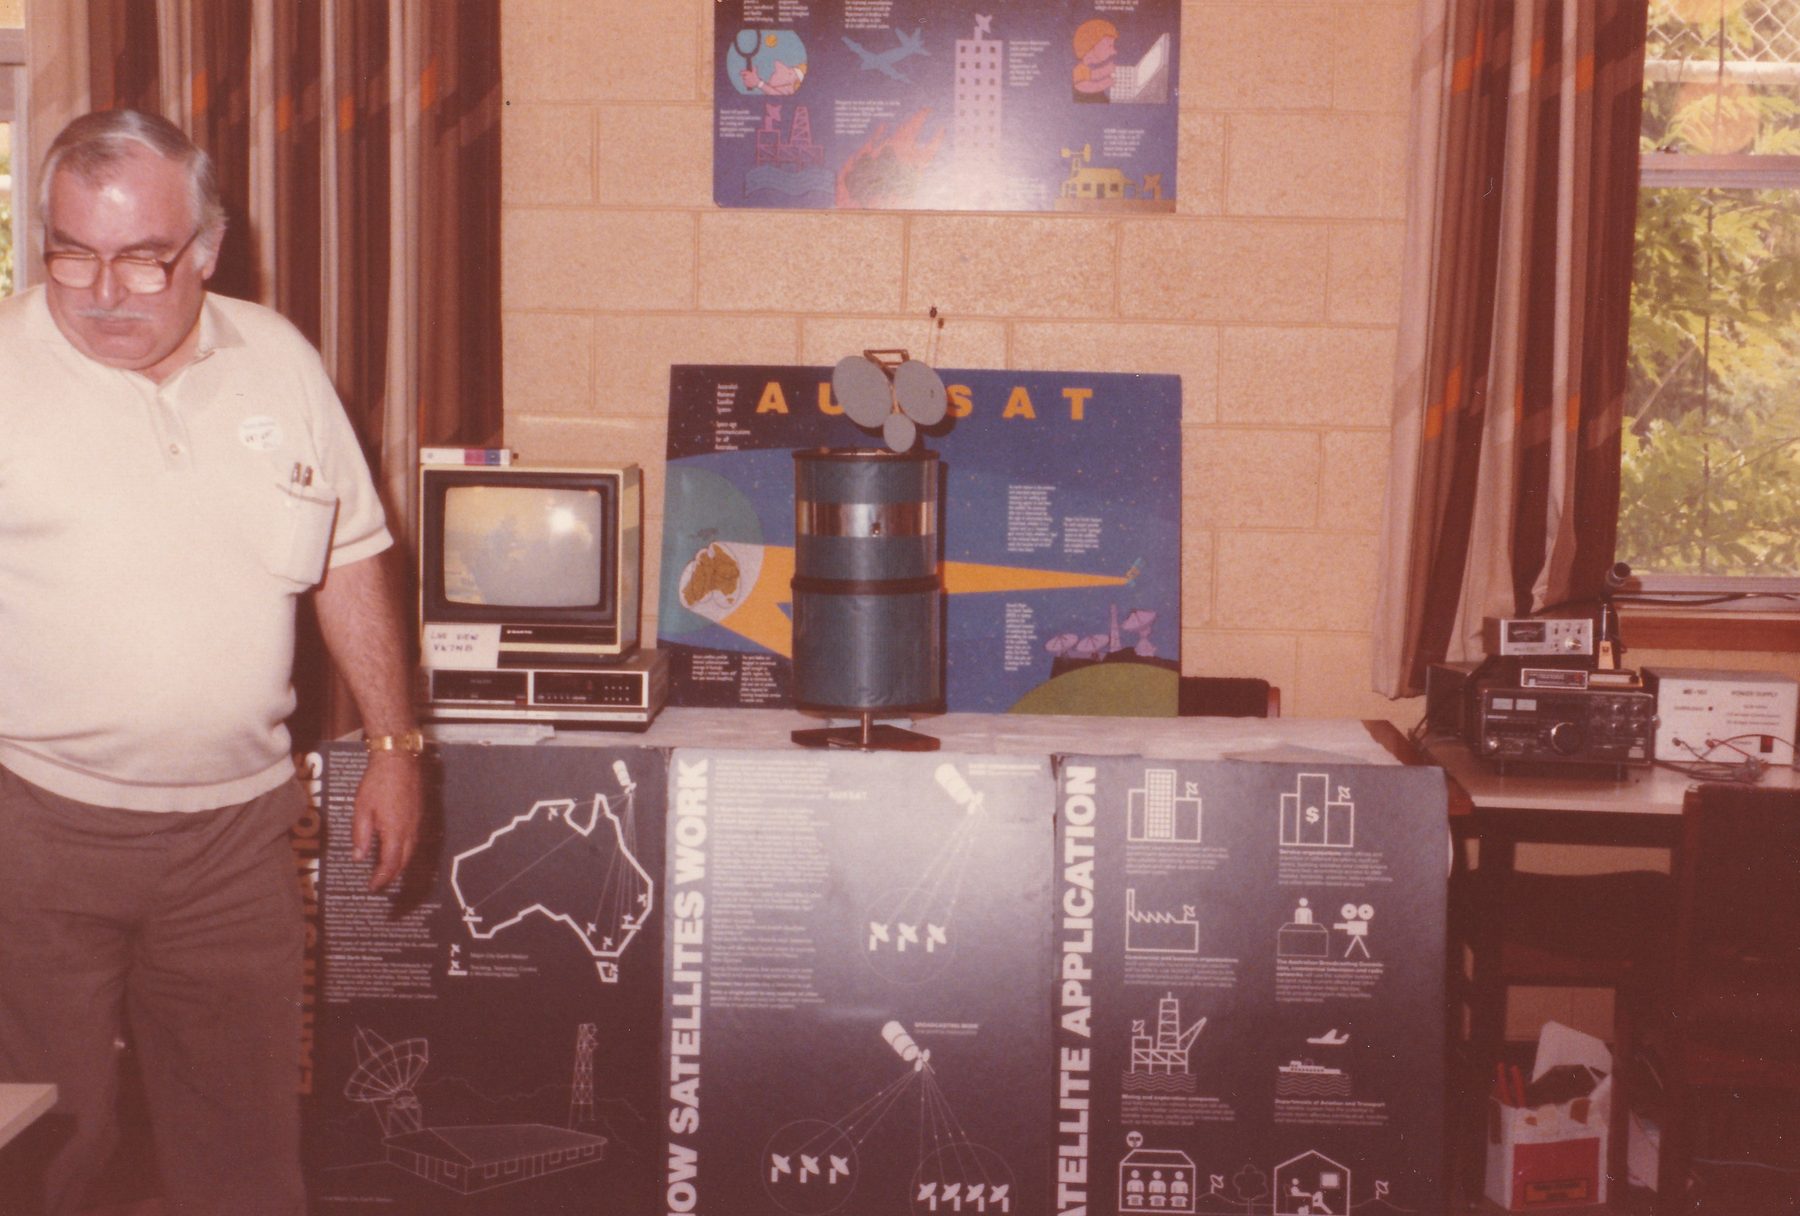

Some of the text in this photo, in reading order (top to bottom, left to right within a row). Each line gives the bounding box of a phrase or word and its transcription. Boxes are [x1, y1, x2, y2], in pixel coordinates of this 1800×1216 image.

[756, 382, 1093, 420] AUSAT
[667, 758, 708, 1216] OW SATELLITES WORK
[1056, 766, 1096, 1216] TELLITE APPLICATION
